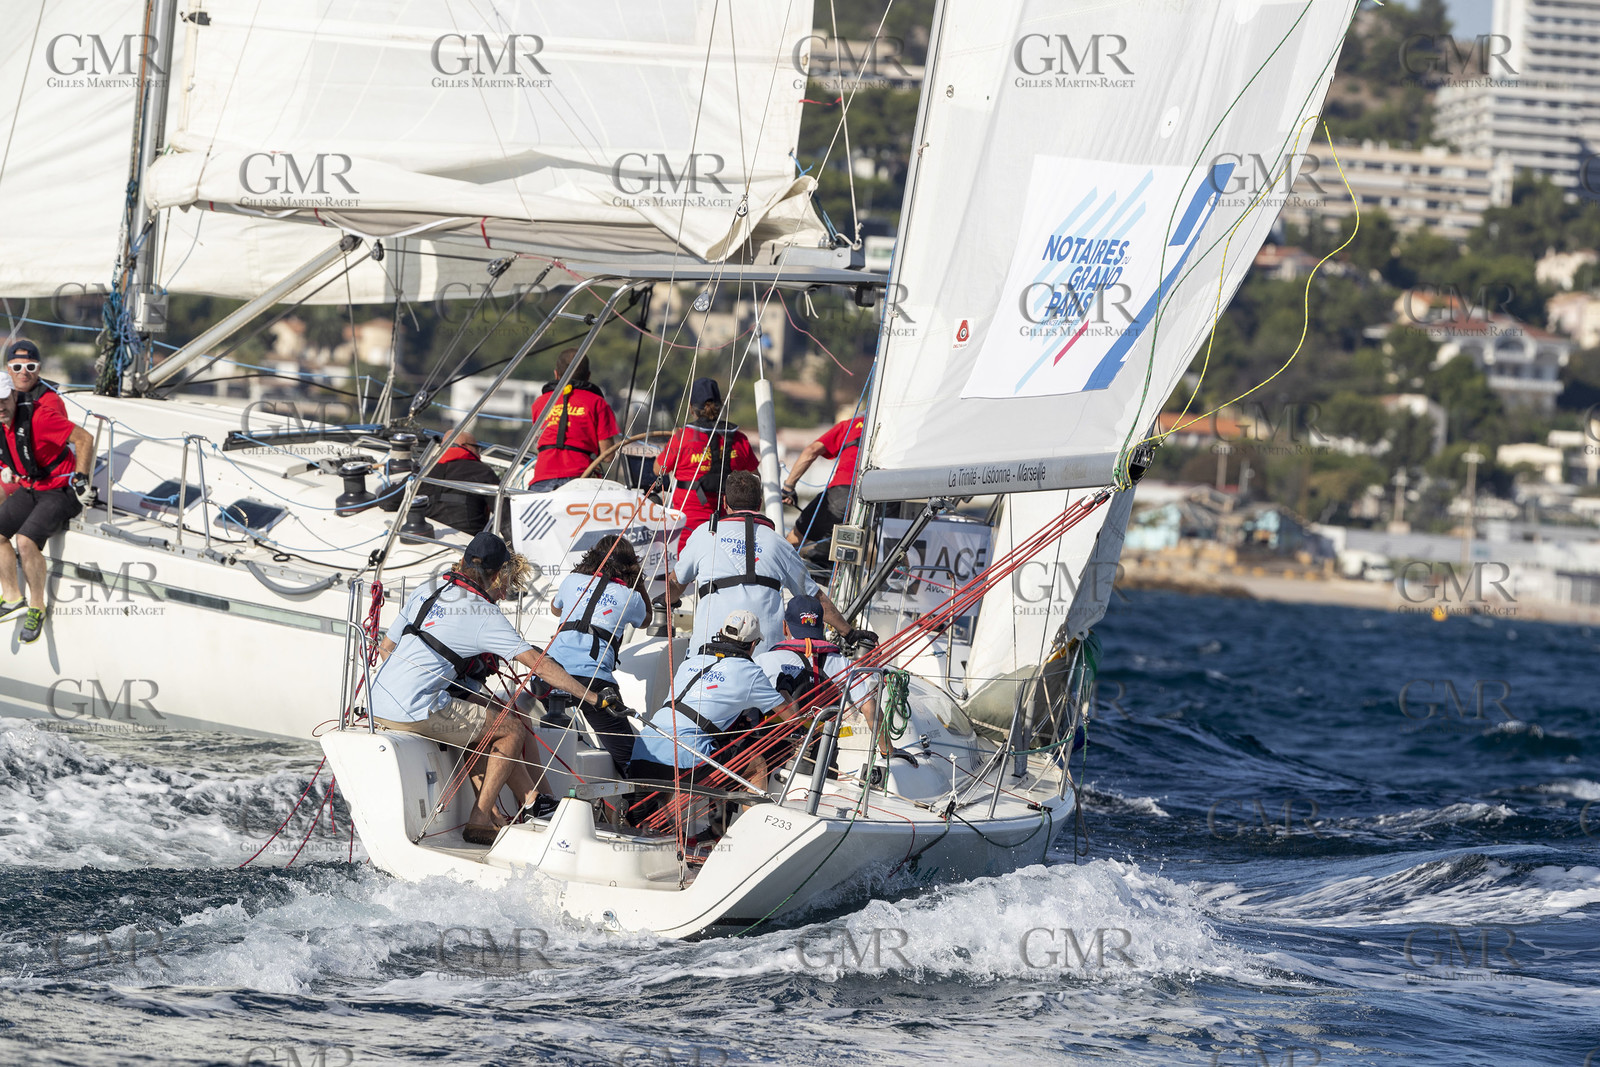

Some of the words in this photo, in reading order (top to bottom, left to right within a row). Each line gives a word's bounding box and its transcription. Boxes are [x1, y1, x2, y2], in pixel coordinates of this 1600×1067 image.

[1042, 235, 1130, 265] NOTAIRES
[1067, 266, 1123, 291] GRAND
[1044, 292, 1094, 317] PARIS
[948, 470, 956, 487] La
[1017, 462, 1046, 481] Marseille
[577, 586, 614, 600] NOTRES
[764, 814, 793, 831] F233
